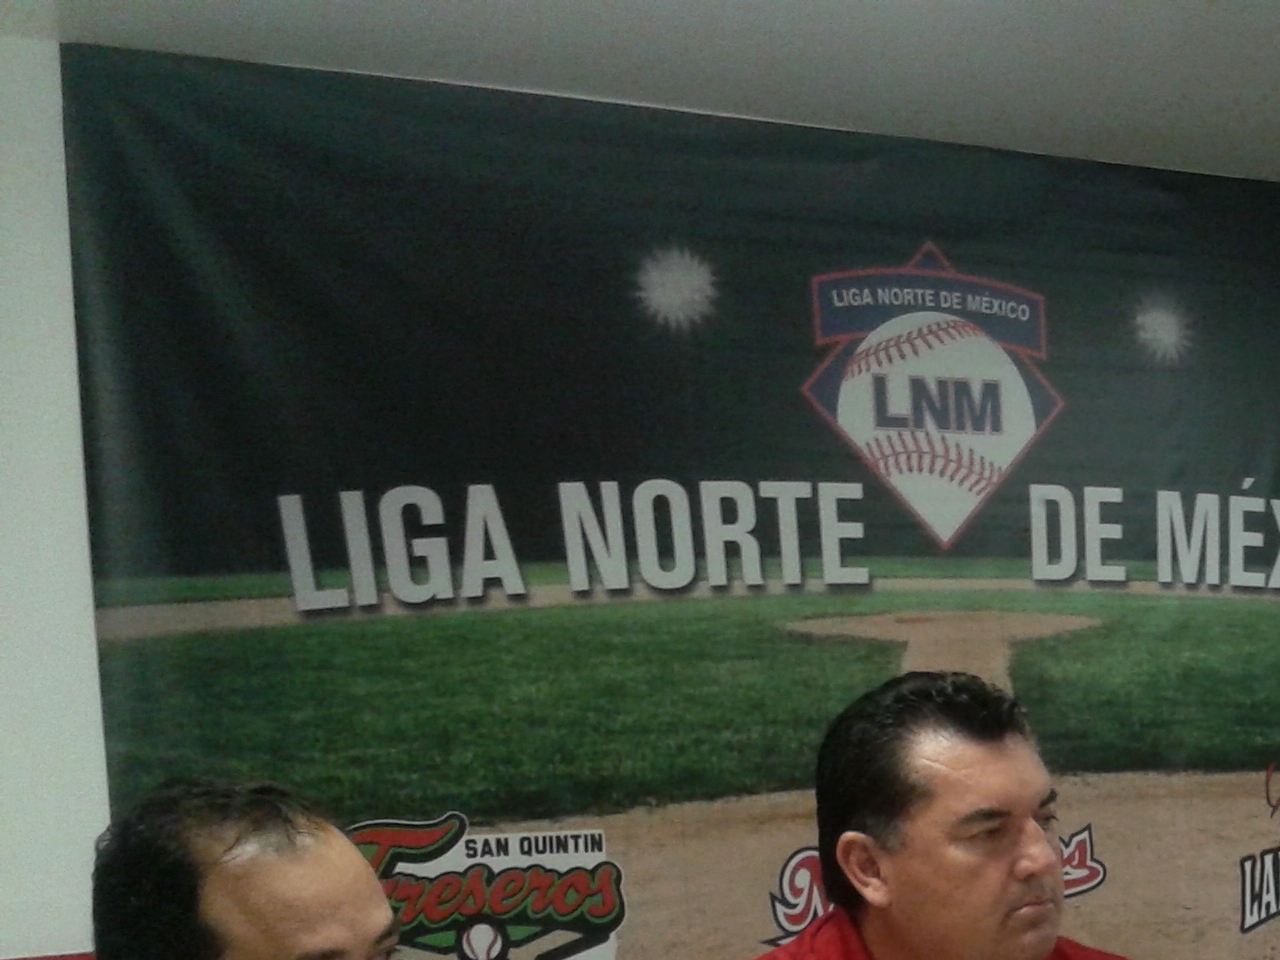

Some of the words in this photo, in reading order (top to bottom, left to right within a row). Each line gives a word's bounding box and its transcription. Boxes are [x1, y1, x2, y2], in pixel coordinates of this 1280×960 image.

[832, 288, 874, 307] LIGA
[877, 288, 936, 307] NORTE
[940, 290, 963, 309] DE
[967, 290, 1030, 321] MÉXICO
[871, 372, 1003, 435] LNM
[278, 483, 527, 613] LIGA
[556, 478, 872, 592] NORTE
[1029, 483, 1127, 582] DE
[464, 835, 510, 858] SAN
[518, 832, 604, 857] QUINTIN
